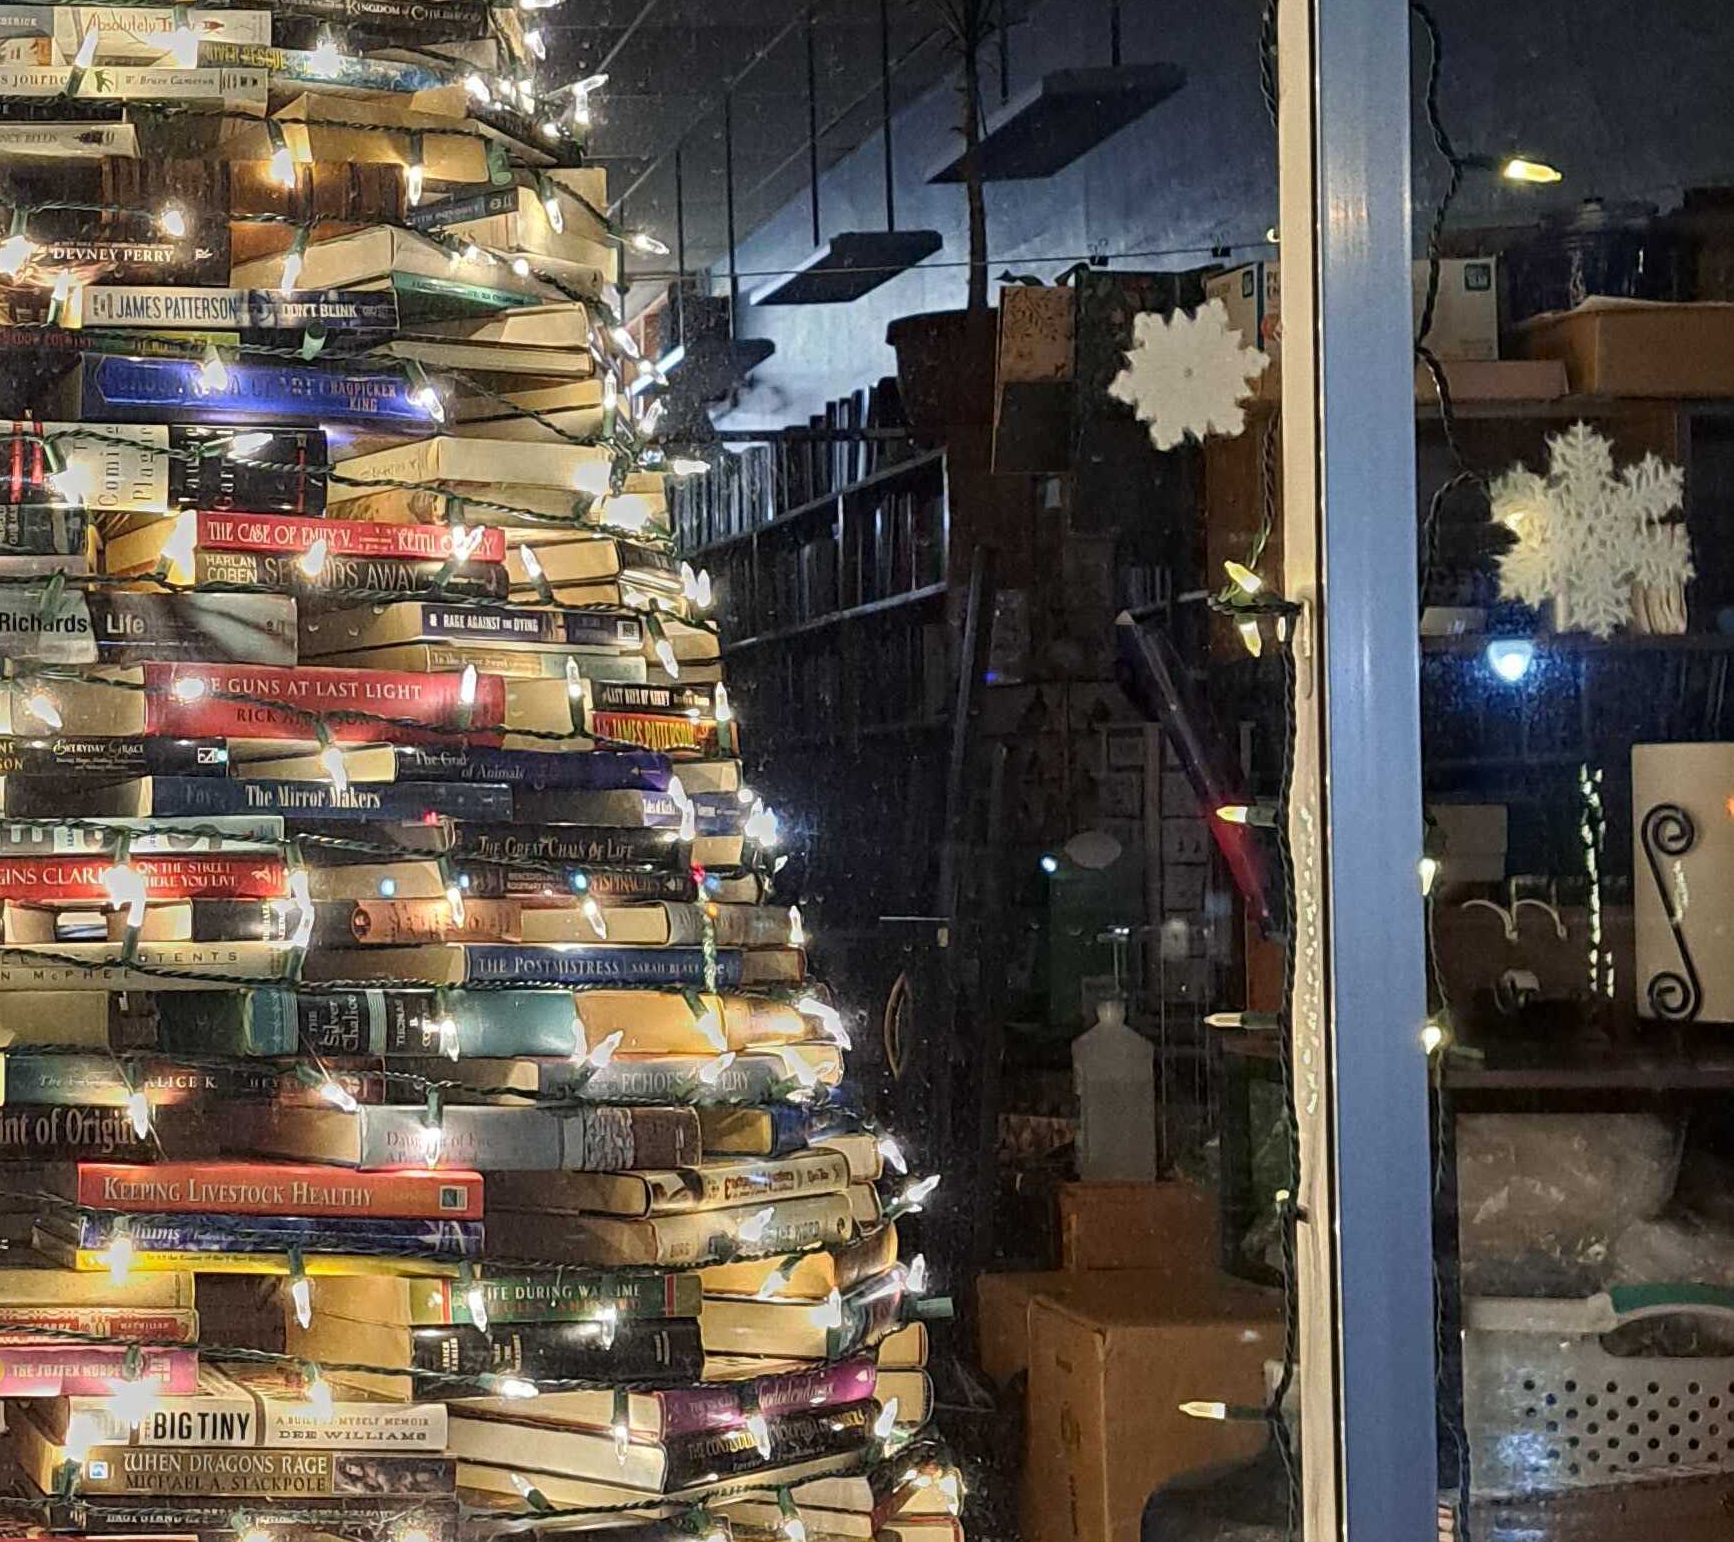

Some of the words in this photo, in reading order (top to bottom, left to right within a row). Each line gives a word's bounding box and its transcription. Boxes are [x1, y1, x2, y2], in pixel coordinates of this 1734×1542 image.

[86, 12, 155, 35] Absolutely
[169, 73, 216, 87] Cameron
[52, 247, 121, 262] DEVNEY
[123, 247, 174, 263] PERRY
[115, 295, 162, 320] JAMES
[164, 295, 238, 320] PATTERSON
[319, 302, 358, 318] BLINK
[329, 381, 397, 398] RAGPICKER
[349, 397, 378, 412] KING
[208, 521, 234, 542] THE
[237, 522, 271, 543] CASE
[275, 525, 298, 545] OF
[301, 526, 338, 547] EMILY
[206, 554, 257, 568] HARLAN
[207, 567, 258, 584] COBEN
[366, 563, 419, 591] AWAY
[106, 613, 145, 635] Life
[467, 614, 501, 631] AGAINST
[228, 678, 280, 695] GUNS
[287, 680, 309, 696] AT
[316, 681, 360, 698] LAST
[366, 682, 424, 700] LIGHT
[236, 708, 276, 724] RICK
[246, 785, 273, 805] The
[277, 786, 325, 807] Mirror
[330, 789, 382, 810] Makers
[478, 958, 507, 974] THE
[513, 956, 619, 976] POSTMISTRESS
[324, 1001, 340, 1048] Silver
[342, 993, 360, 1049] Chalice
[621, 1072, 685, 1093] ECHOES
[35, 1110, 60, 1146] of
[65, 1106, 139, 1151] Origin
[104, 1176, 181, 1202] KEEPING
[188, 1178, 284, 1205] LIVESTOCK
[290, 1180, 374, 1207] HEALTHY
[515, 1285, 574, 1300] DURING
[153, 1412, 193, 1441] BIG
[199, 1413, 251, 1442] TINY
[384, 1416, 430, 1427] MEMOIR
[324, 1428, 428, 1442] WILLIAMS
[123, 1453, 182, 1473] WHEN
[190, 1455, 276, 1475] DRAGONS
[281, 1456, 327, 1476] RAGE
[125, 1473, 206, 1492] MICHAEL
[231, 1475, 327, 1493] STACKPOLE
